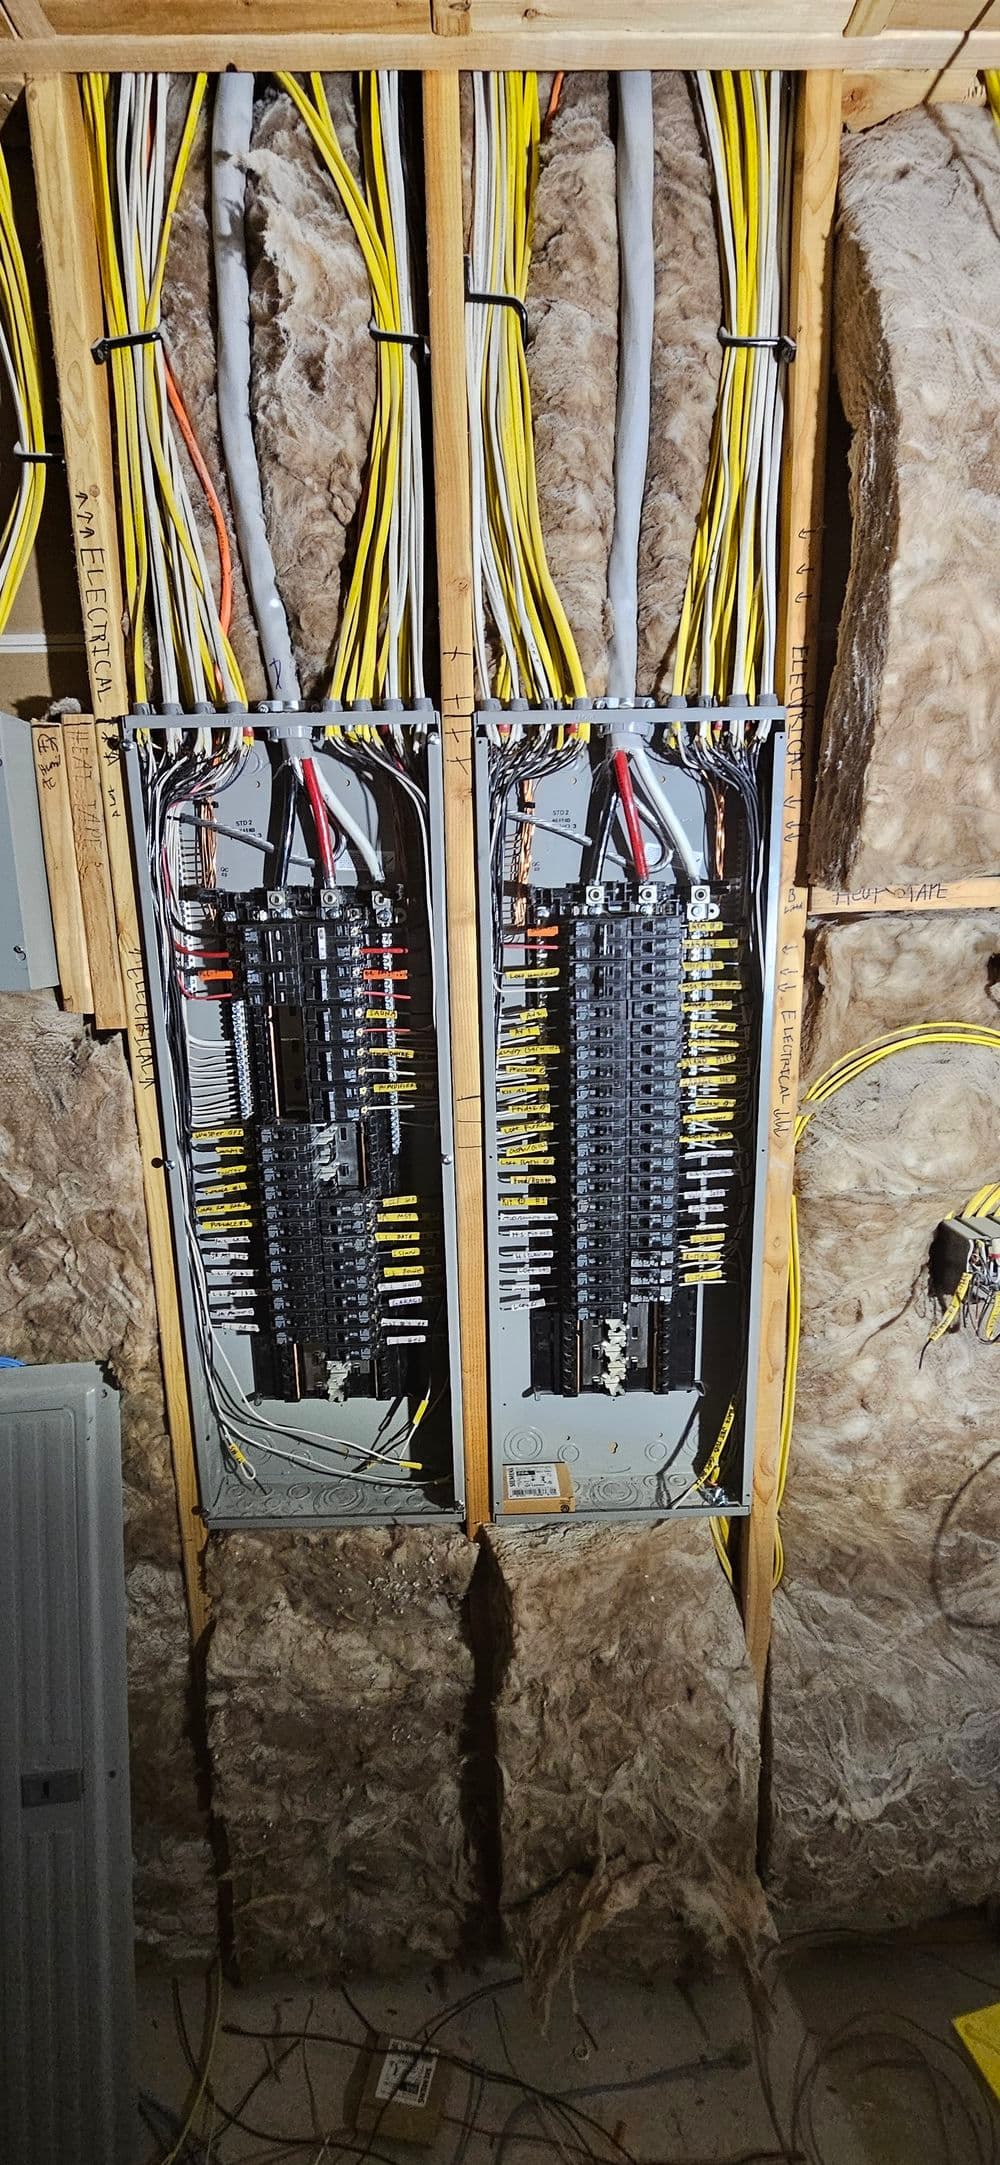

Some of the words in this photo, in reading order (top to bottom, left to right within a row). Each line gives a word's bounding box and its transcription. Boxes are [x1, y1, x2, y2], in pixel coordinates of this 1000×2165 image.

[80, 548, 112, 703] ELECTRICAL
[67, 730, 92, 783] HEAT
[786, 646, 814, 780] ELECTRICAL
[368, 1010, 396, 1018] SAUNA
[778, 1010, 797, 1105] ELECTRICAL
